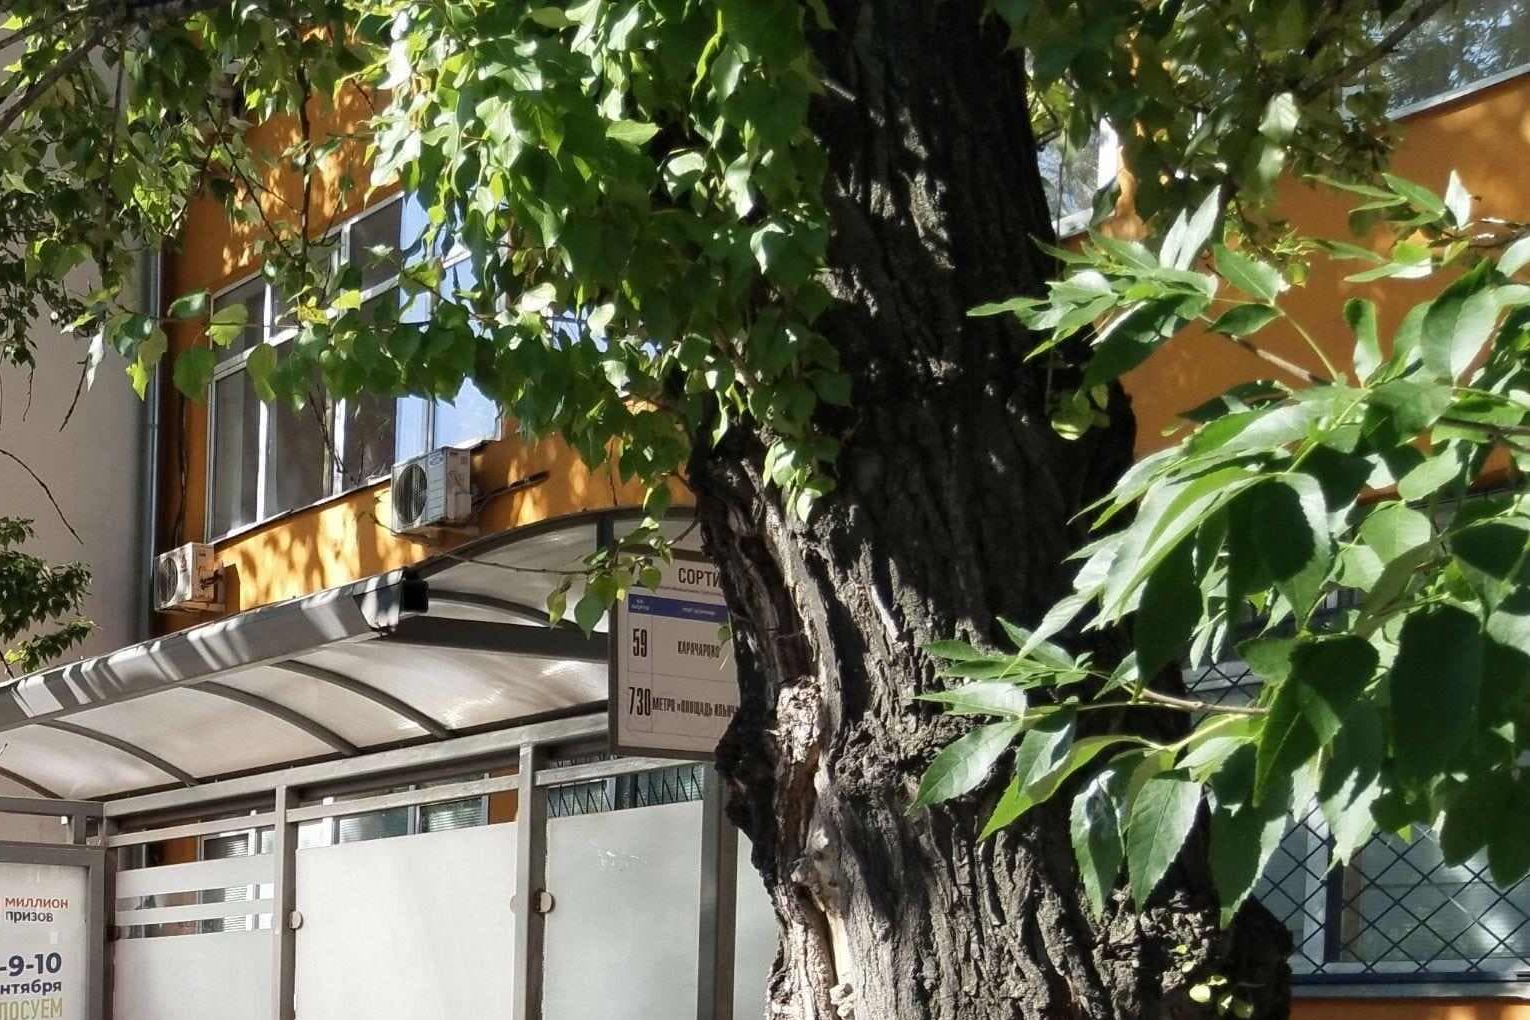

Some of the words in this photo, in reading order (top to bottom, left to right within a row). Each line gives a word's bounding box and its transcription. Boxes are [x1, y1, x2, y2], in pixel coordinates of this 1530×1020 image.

[632, 628, 648, 658] 59
[629, 687, 651, 716] 730
[652, 697, 676, 712] МЕТРО
